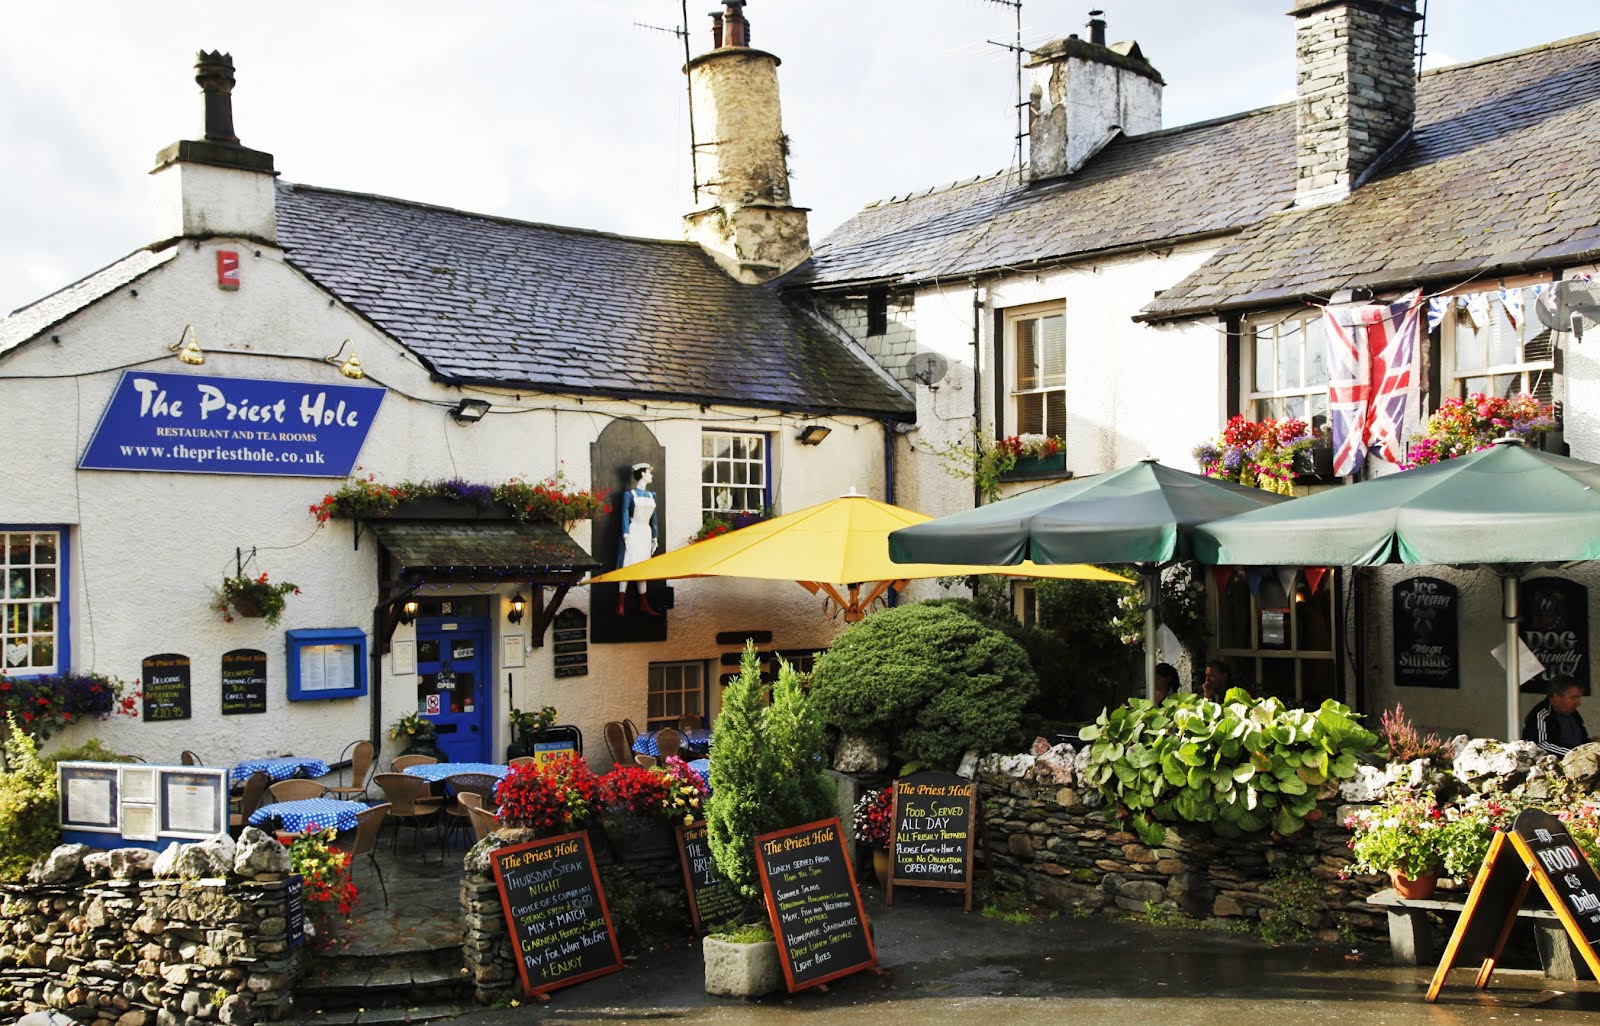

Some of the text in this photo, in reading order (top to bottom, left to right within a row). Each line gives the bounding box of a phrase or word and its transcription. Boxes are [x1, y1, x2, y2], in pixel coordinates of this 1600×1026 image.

[133, 378, 359, 428] The Priest Hole
[156, 426, 317, 443] RESTAURANT AND TEA ROOMS
[120, 444, 326, 464] www.thepriesthole.co.uk
[898, 782, 971, 797] The Priest Hole
[905, 801, 964, 817] FOOD SERVED
[901, 817, 950, 831] ALL DAY
[684, 830, 697, 841] The
[764, 828, 834, 855] The Priest Hole
[896, 829, 967, 843] ALL FRESHLY PREPARED
[502, 840, 578, 870] The Priest Hole
[686, 842, 704, 858] THE
[896, 843, 919, 854] PLEASE
[920, 843, 936, 854] COME
[941, 843, 954, 854] HAVE
[956, 844, 962, 852] A
[767, 855, 831, 875] LUNCH SERVED FROM
[904, 864, 927, 873] OPEN
[928, 863, 947, 874] FROM
[927, 854, 963, 864] OBLIGATION
[1538, 845, 1579, 873] FOOD
[504, 860, 584, 891] THURSDAY STEAK
[529, 877, 562, 897] NIGHT
[776, 884, 820, 901] SUMMER SALADS
[511, 901, 539, 917] CHOICE
[540, 898, 551, 908] OF
[558, 884, 591, 901] CUMBRIAN
[800, 906, 813, 916] FISH
[822, 901, 851, 911] VEGETARIAN
[521, 912, 546, 927] STEAKS
[547, 905, 565, 916] FROM
[528, 909, 586, 936] MIX + MATCH
[804, 913, 828, 925] PLATTERS
[559, 927, 582, 940] POTATO
[584, 917, 605, 931] SAUCE
[787, 917, 858, 946] HOMEMADE SANDWICHES
[524, 954, 542, 969] PAY
[545, 948, 560, 962] FOR
[561, 941, 580, 955] WHAT
[790, 931, 852, 960] DAILY LUNCH SPECIALS
[541, 955, 583, 978] + ENJOY
[794, 951, 832, 973] LIGHT BITES
